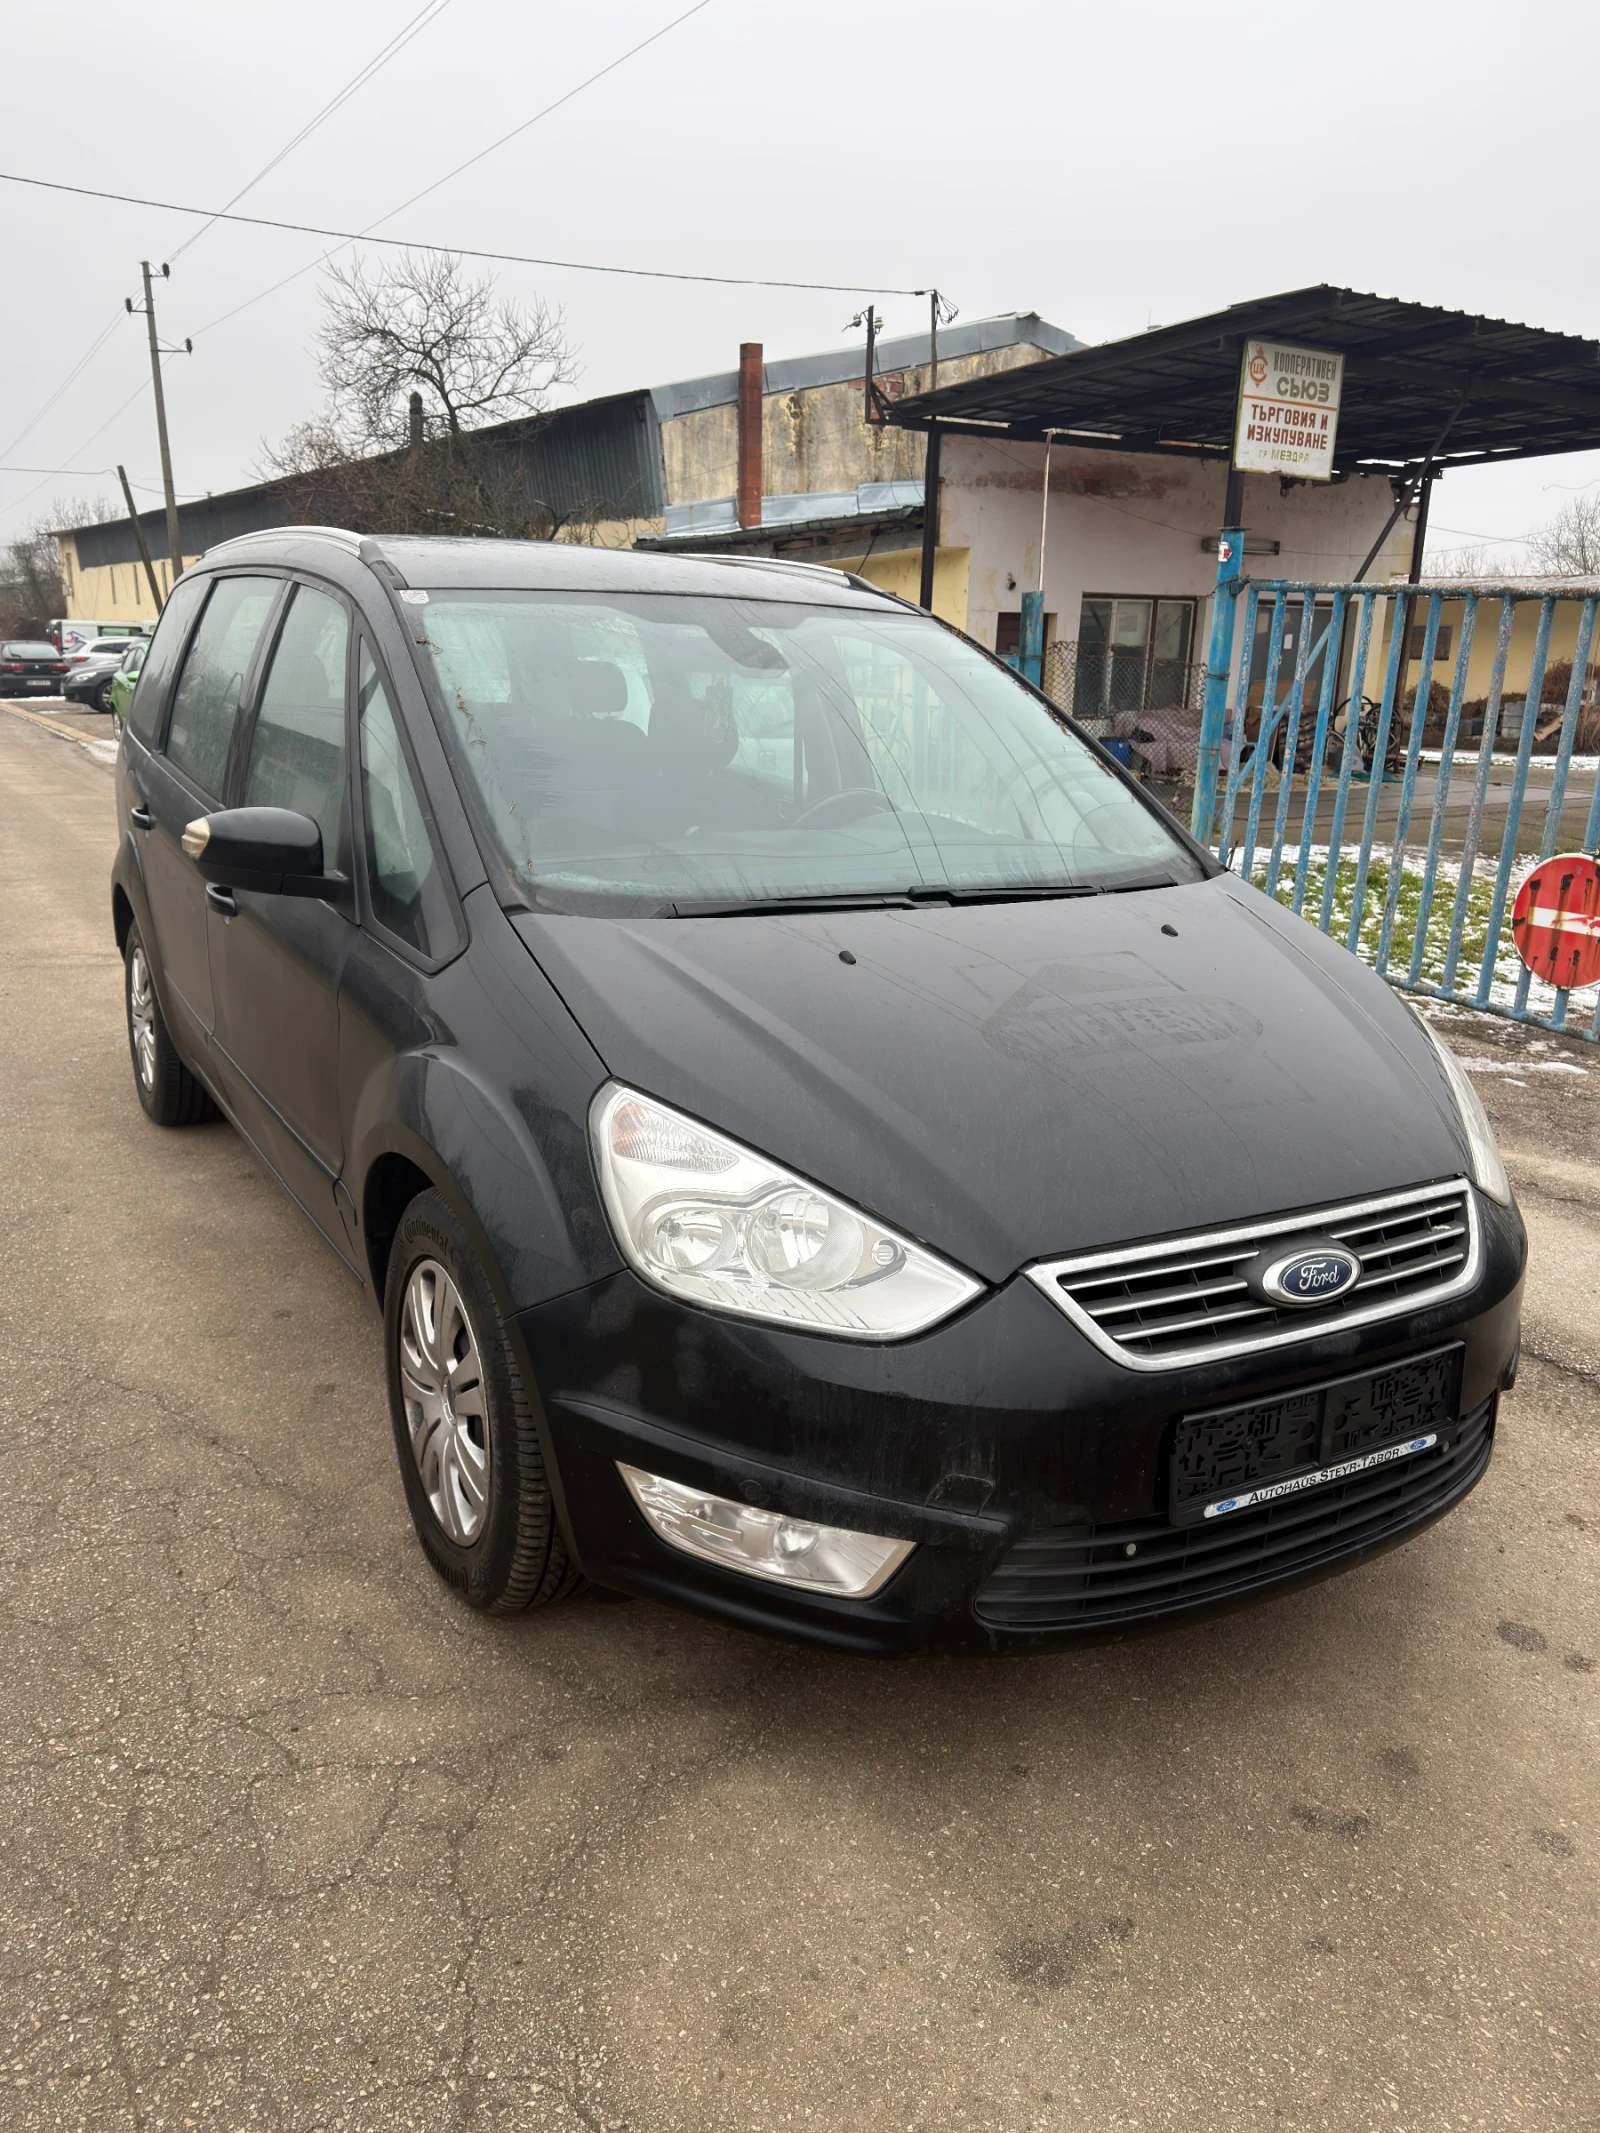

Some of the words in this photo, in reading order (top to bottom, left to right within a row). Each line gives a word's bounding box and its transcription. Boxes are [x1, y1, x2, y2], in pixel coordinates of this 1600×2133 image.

[1273, 351, 1338, 381] КООПЕРАТИВЕН
[1320, 414, 1328, 431] И
[1246, 424, 1328, 450] ИЗКУПУВАНЕ
[1271, 448, 1310, 463] МЕЗДРА
[404, 1214, 449, 1256] Continental
[1299, 1262, 1340, 1291] Ford
[1218, 1499, 1235, 1512] Ford
